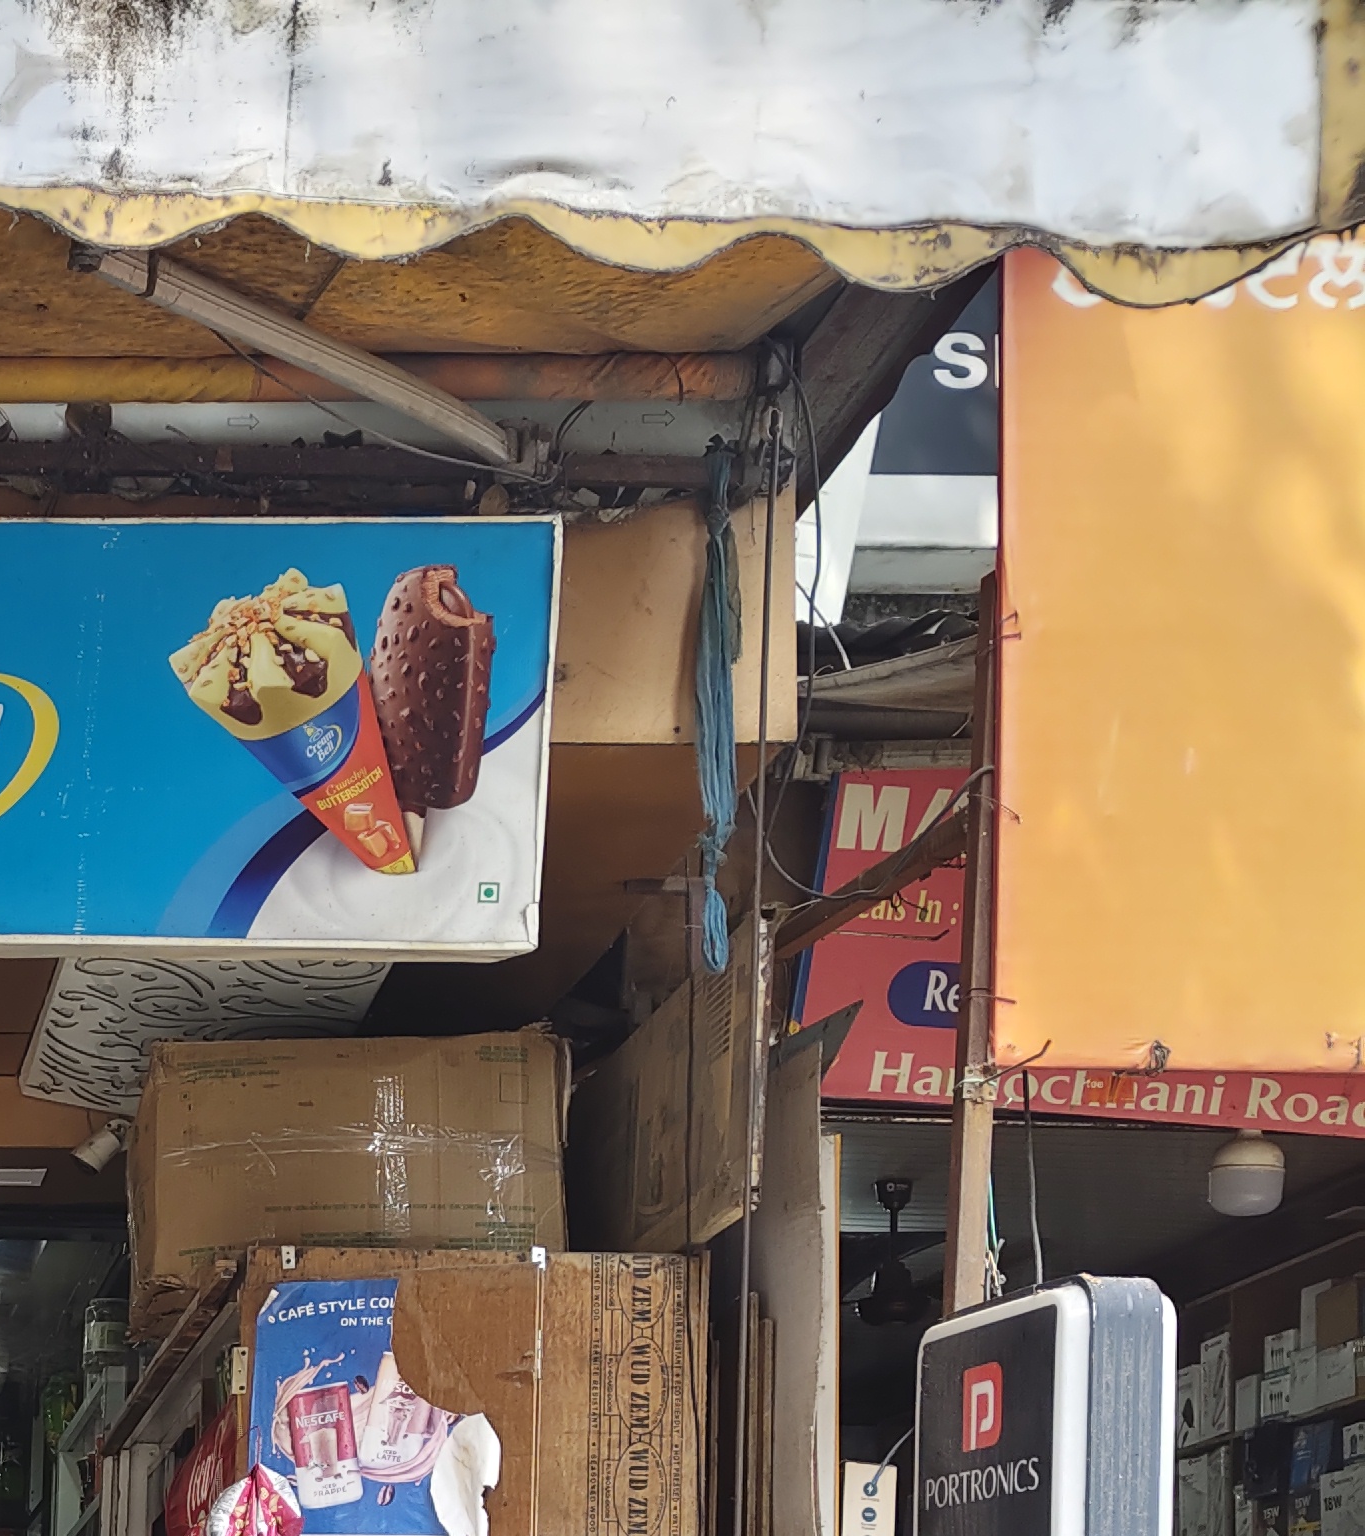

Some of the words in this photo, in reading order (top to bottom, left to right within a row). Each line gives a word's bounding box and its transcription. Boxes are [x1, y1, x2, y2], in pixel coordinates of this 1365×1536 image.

[317, 766, 385, 812] BUTTERSCOTCH
[922, 969, 960, 1013] Re
[278, 1302, 315, 1322] CAFÉ
[318, 1298, 366, 1315] STYLE
[370, 1296, 395, 1309] COL
[340, 1317, 358, 1328] ON
[360, 1317, 383, 1327] THE
[630, 1343, 651, 1385] WUD
[630, 1392, 650, 1429] ZEM
[629, 1449, 649, 1490] WUD
[925, 1457, 1040, 1511] PORTRONICS
[627, 1498, 648, 1535] ZEM
